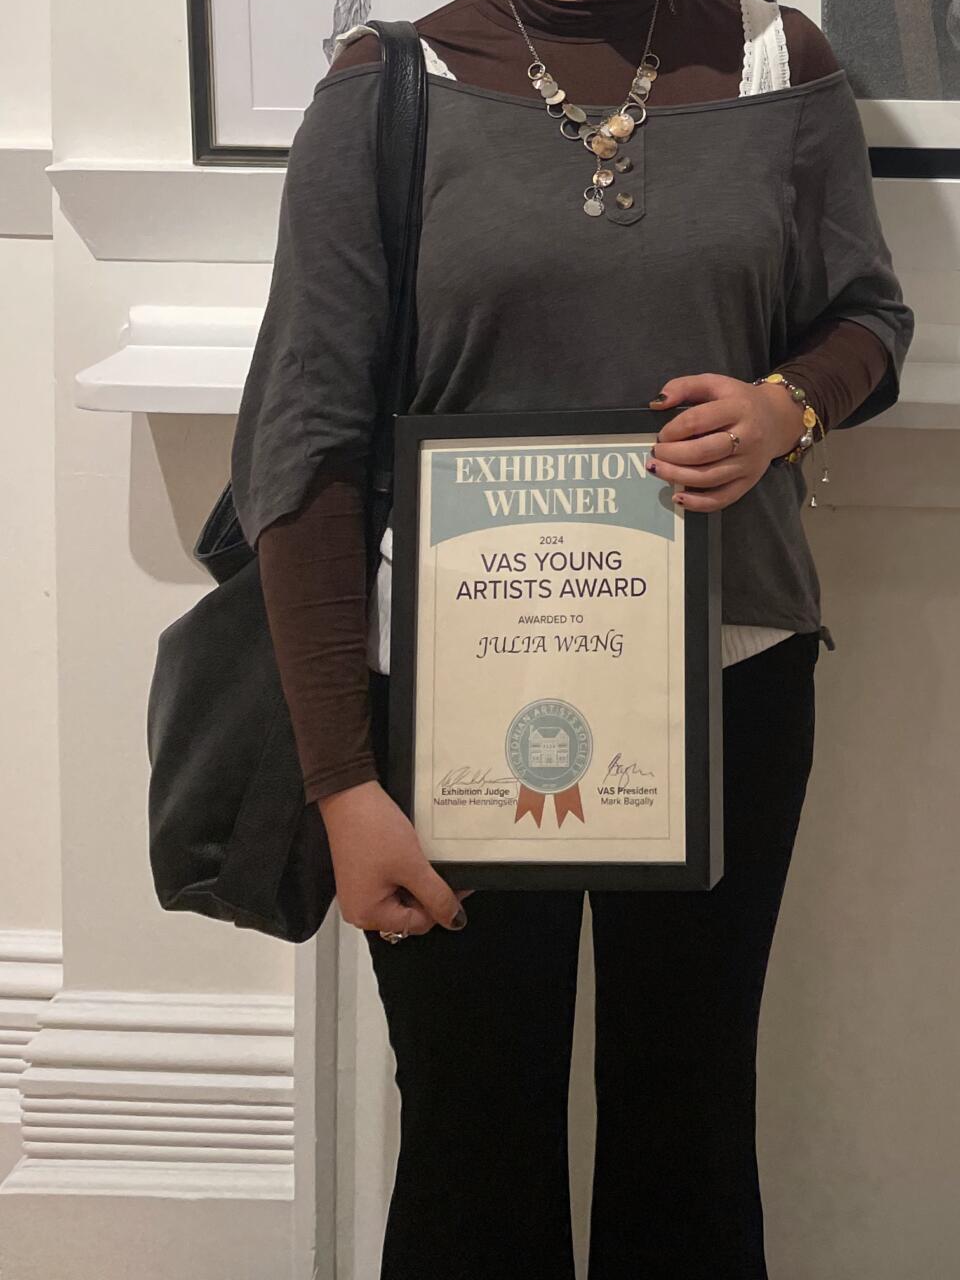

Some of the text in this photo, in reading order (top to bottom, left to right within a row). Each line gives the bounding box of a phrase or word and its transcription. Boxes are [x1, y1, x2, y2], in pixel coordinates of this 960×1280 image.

[455, 452, 648, 483] EXHIBITION
[484, 487, 619, 517] WINNER
[539, 535, 564, 545] 2024
[481, 550, 622, 573] VAS YOUNG
[456, 577, 647, 600] ARTISTS AWARD
[518, 614, 584, 625] AWARDED TO
[476, 629, 623, 658] JULIA WANG
[441, 787, 510, 797] Exhibition Judge
[597, 786, 657, 795] VAS President
[433, 798, 467, 806] Nathalie
[600, 797, 621, 806] Mark
